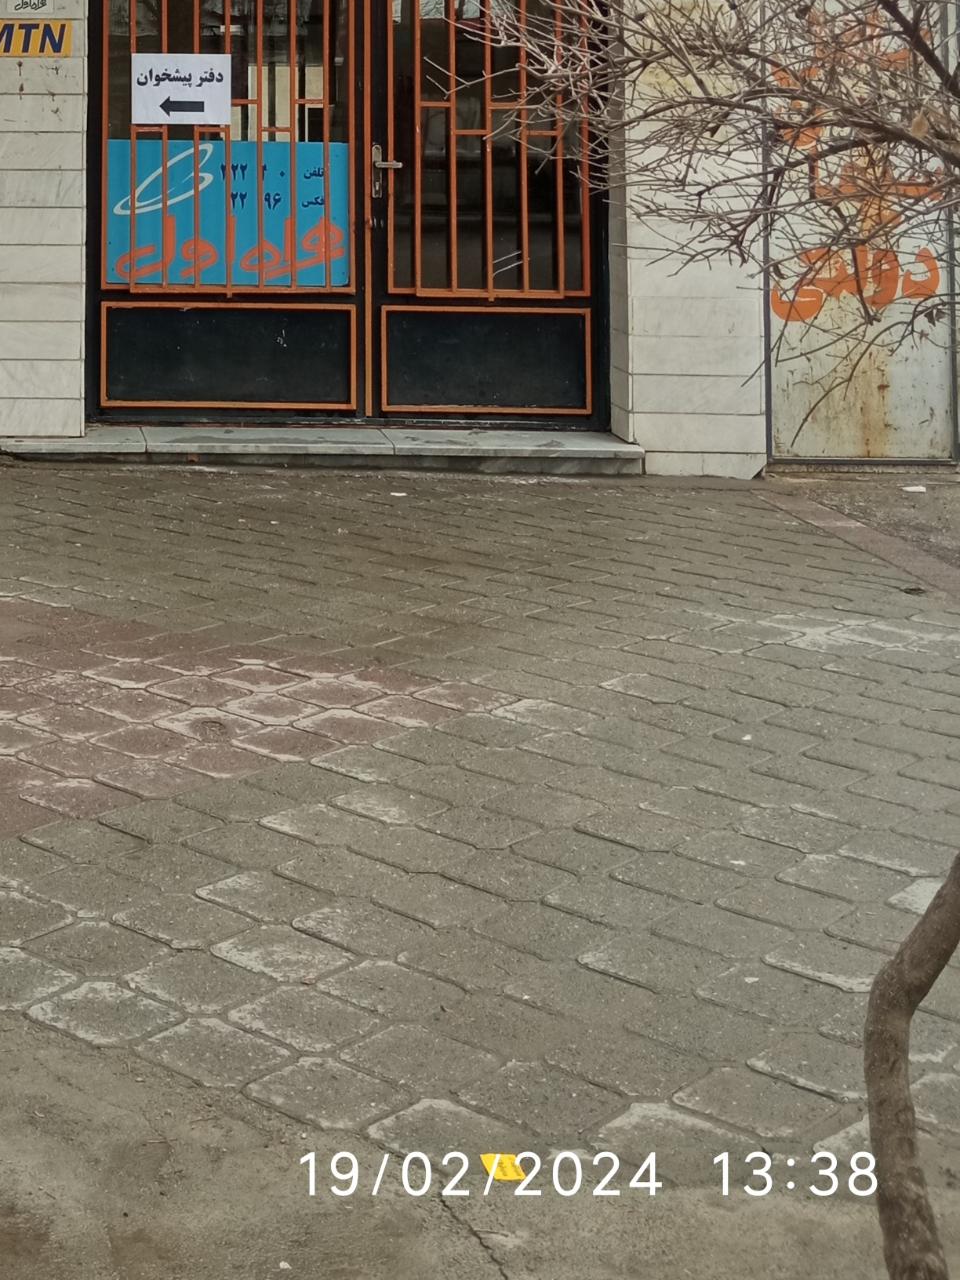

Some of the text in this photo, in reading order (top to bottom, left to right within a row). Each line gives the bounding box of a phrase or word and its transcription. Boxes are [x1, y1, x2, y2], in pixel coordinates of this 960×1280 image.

[136, 67, 225, 88] دفتر پیشخوان
[114, 215, 238, 281] اول
